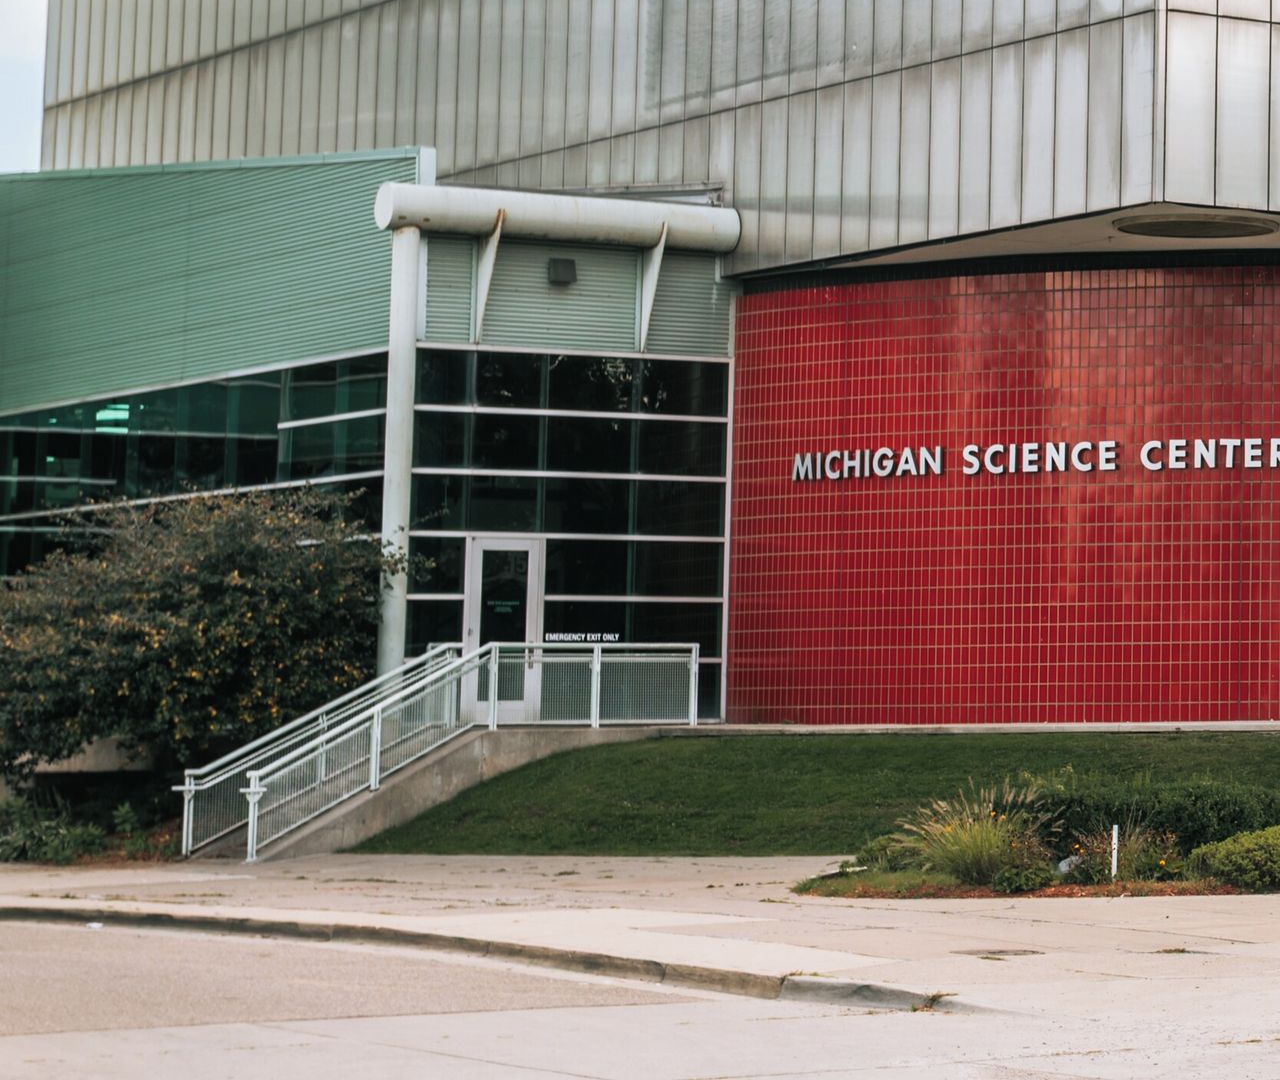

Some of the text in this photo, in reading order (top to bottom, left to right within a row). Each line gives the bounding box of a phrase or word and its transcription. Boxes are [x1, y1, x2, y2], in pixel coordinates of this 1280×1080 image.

[791, 446, 943, 481] MICHIGAN
[963, 441, 1120, 475] SCIENCE
[545, 633, 620, 641] EMERGENCY EXIT ONLY
